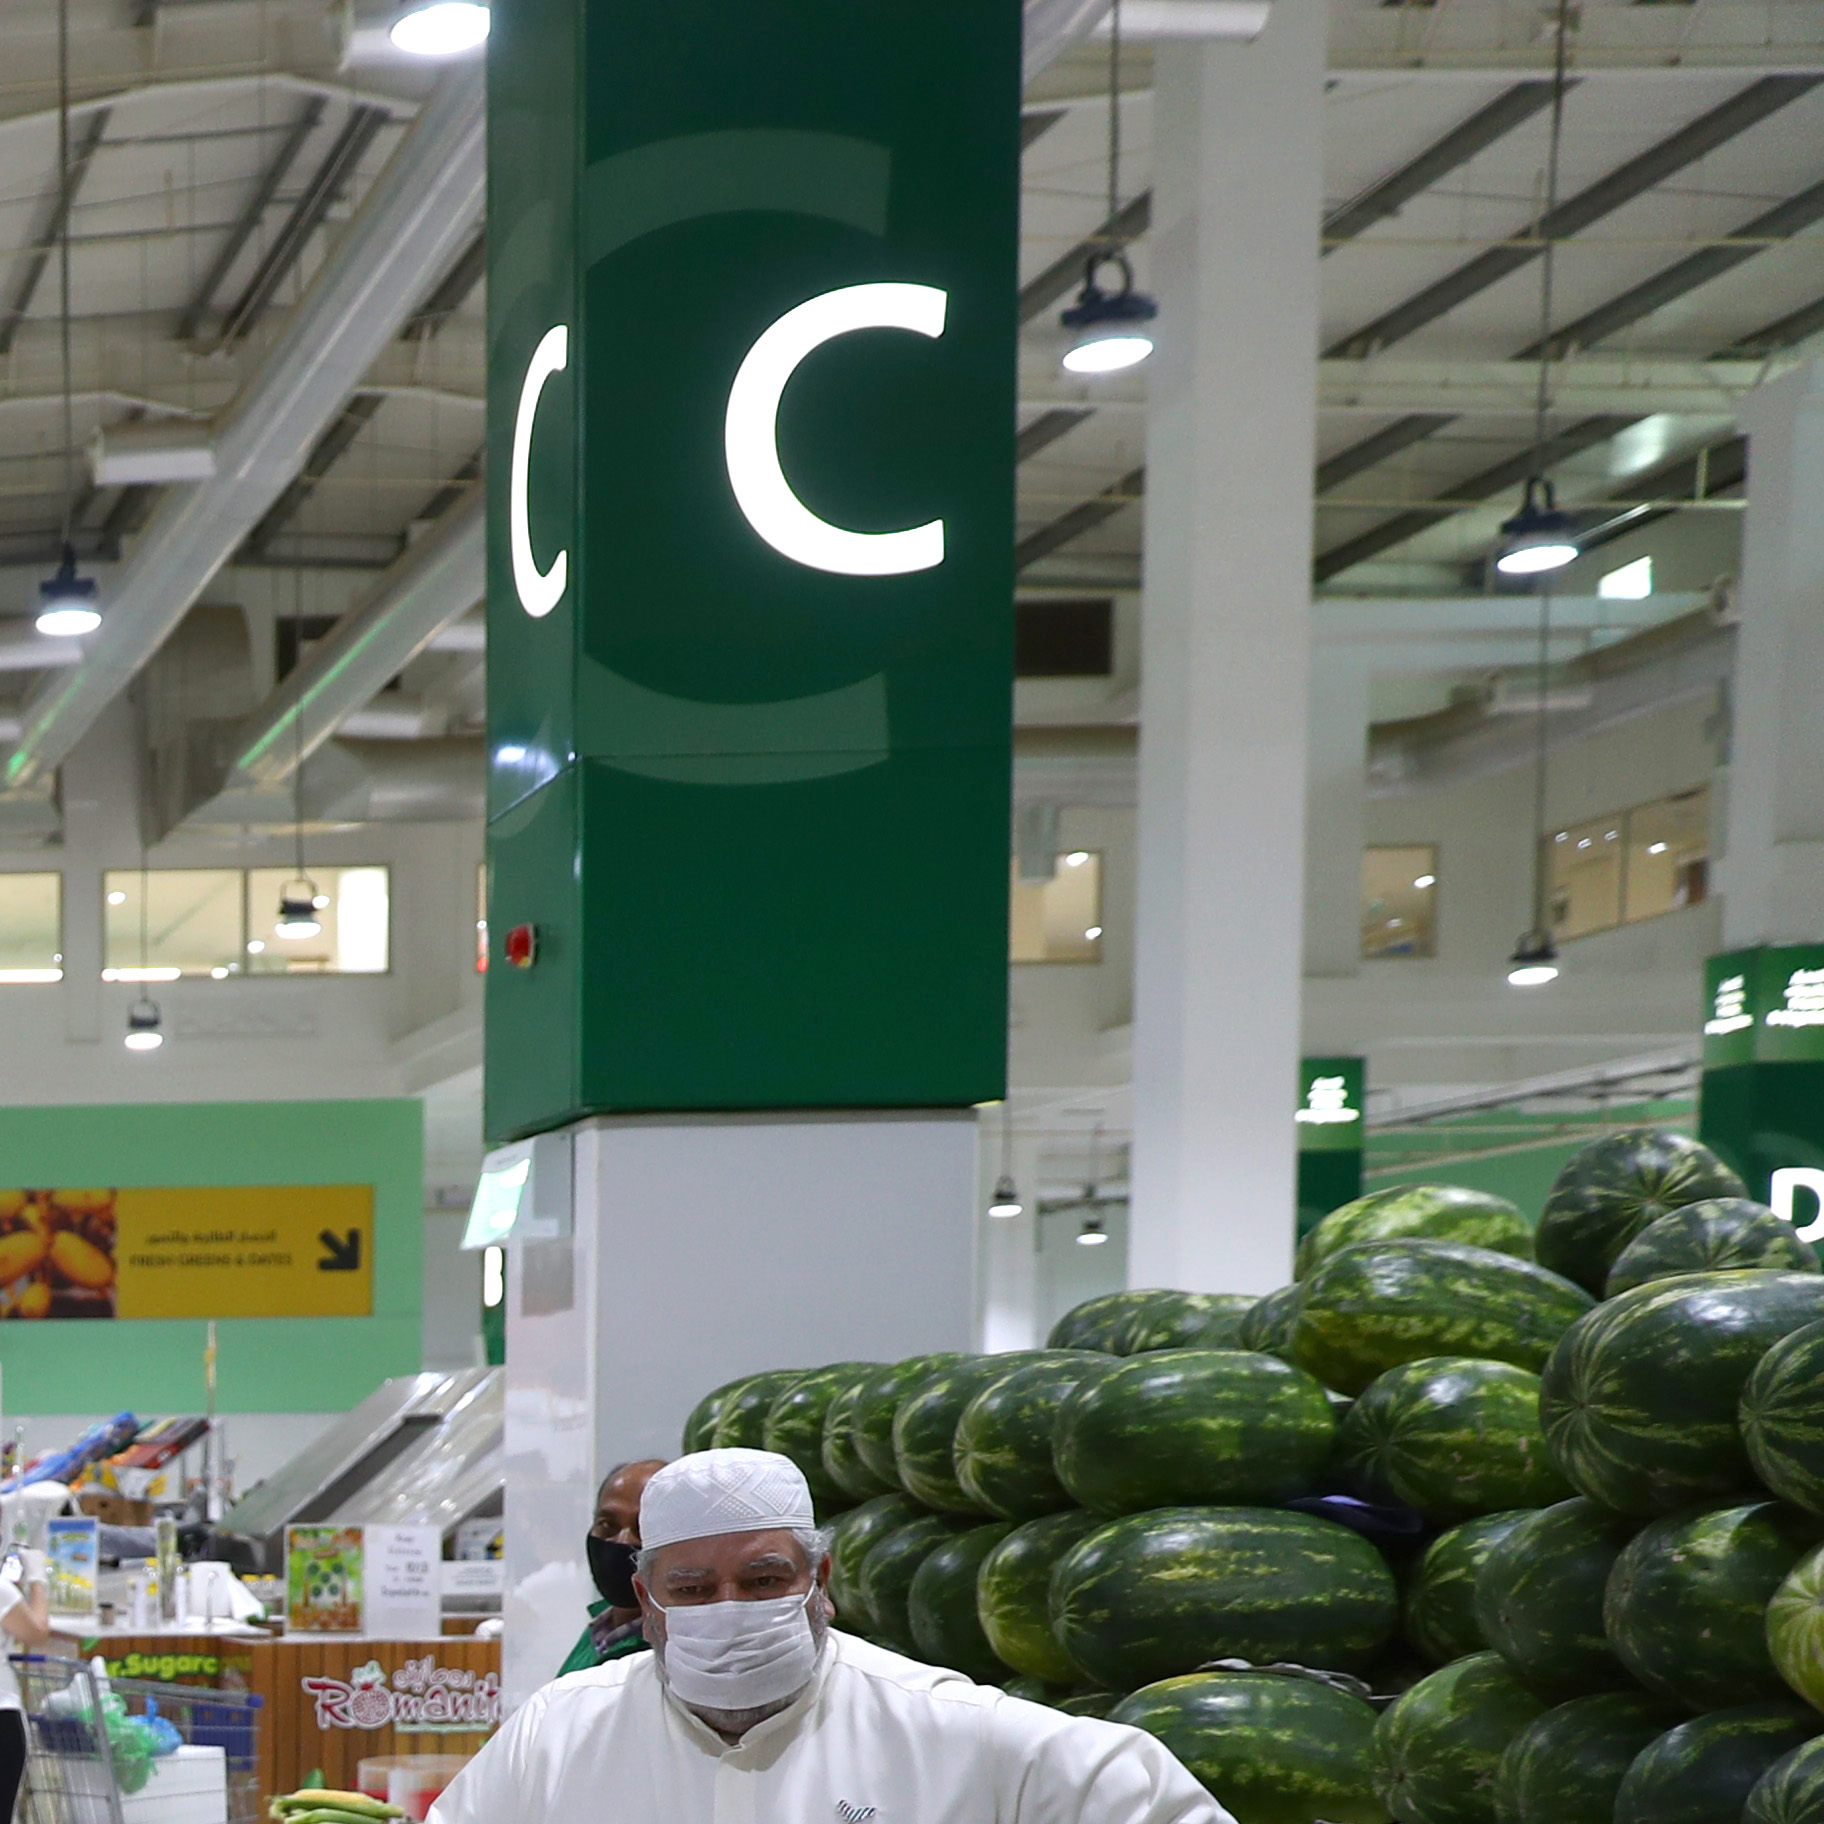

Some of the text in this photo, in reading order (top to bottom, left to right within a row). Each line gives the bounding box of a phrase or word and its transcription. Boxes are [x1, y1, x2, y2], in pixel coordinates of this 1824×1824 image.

[511, 325, 568, 617] C
[724, 282, 947, 575] C
[1769, 1167, 1824, 1244] D
